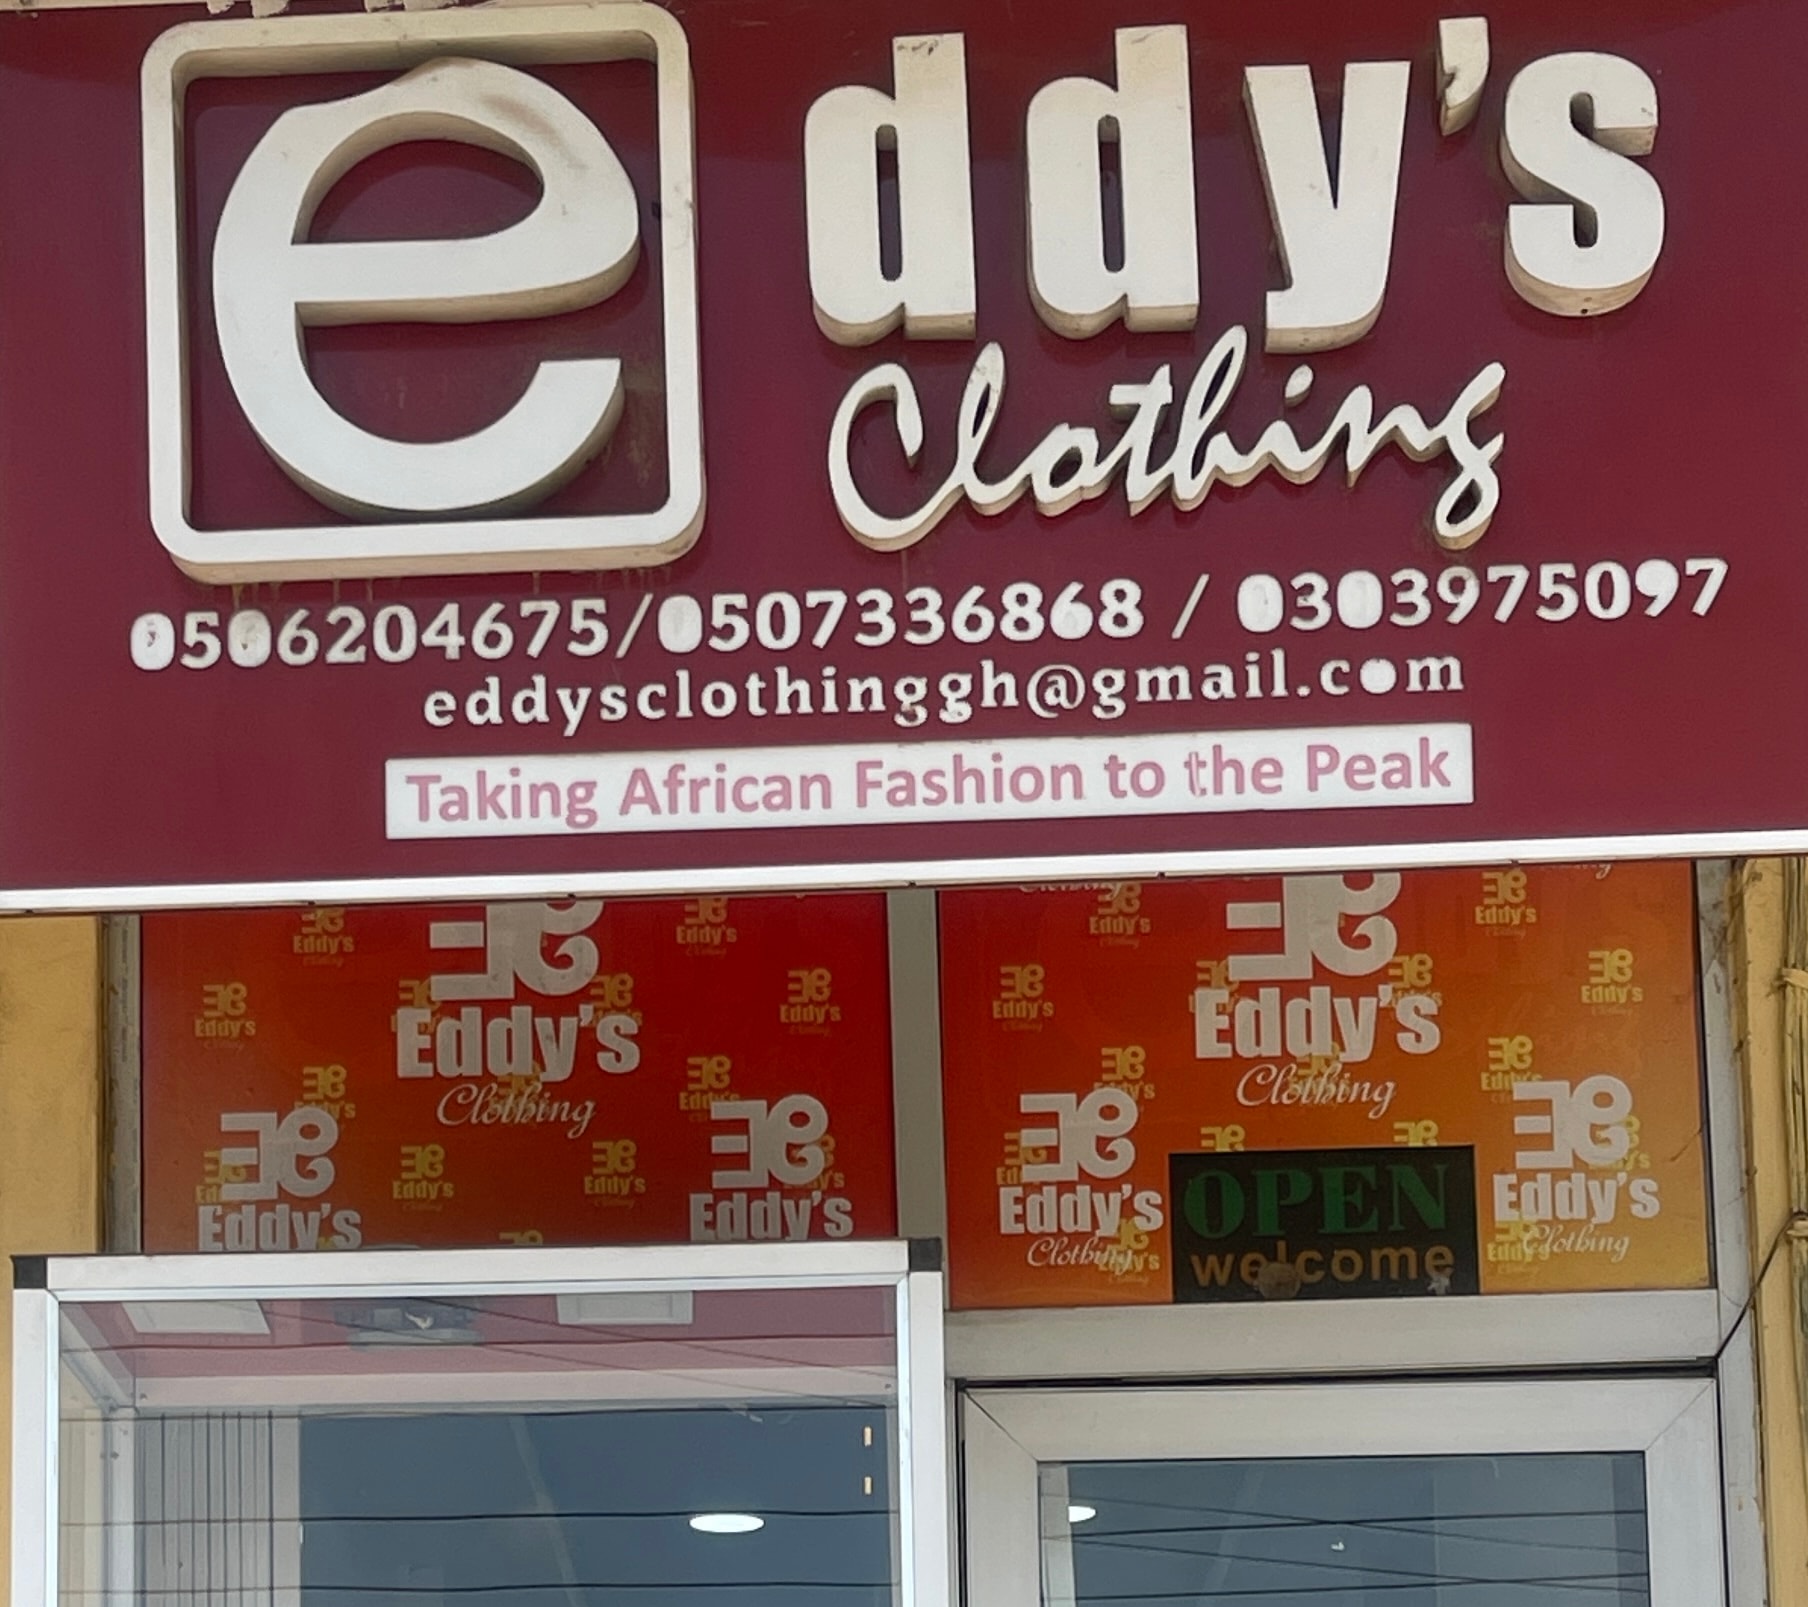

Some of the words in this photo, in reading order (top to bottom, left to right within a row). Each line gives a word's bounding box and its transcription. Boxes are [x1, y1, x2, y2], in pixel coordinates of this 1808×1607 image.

[828, 325, 1506, 553] Clothing
[1236, 557, 1729, 633] 0303975097
[423, 648, 1465, 736] eddysclothinggh@gmail.com
[406, 767, 598, 829] Taking
[619, 762, 832, 817] African
[856, 753, 1083, 809] Fashion
[1104, 754, 1165, 800] to
[1184, 744, 1284, 798] the
[1307, 737, 1452, 793] Peak
[397, 1004, 640, 1083] Eddy's
[1195, 986, 1441, 1063] Eddy's
[437, 1083, 596, 1139] Clothing
[1236, 1062, 1396, 1120] Clothing
[198, 1202, 362, 1252] Eddy's
[689, 1190, 854, 1242] Eddy's
[1000, 1185, 1164, 1238] Eddy's
[1184, 1163, 1447, 1240] OPEN
[1493, 1171, 1660, 1225] Eddy's
[1191, 1239, 1455, 1289] welcome
[1522, 1223, 1630, 1263] Clothing
